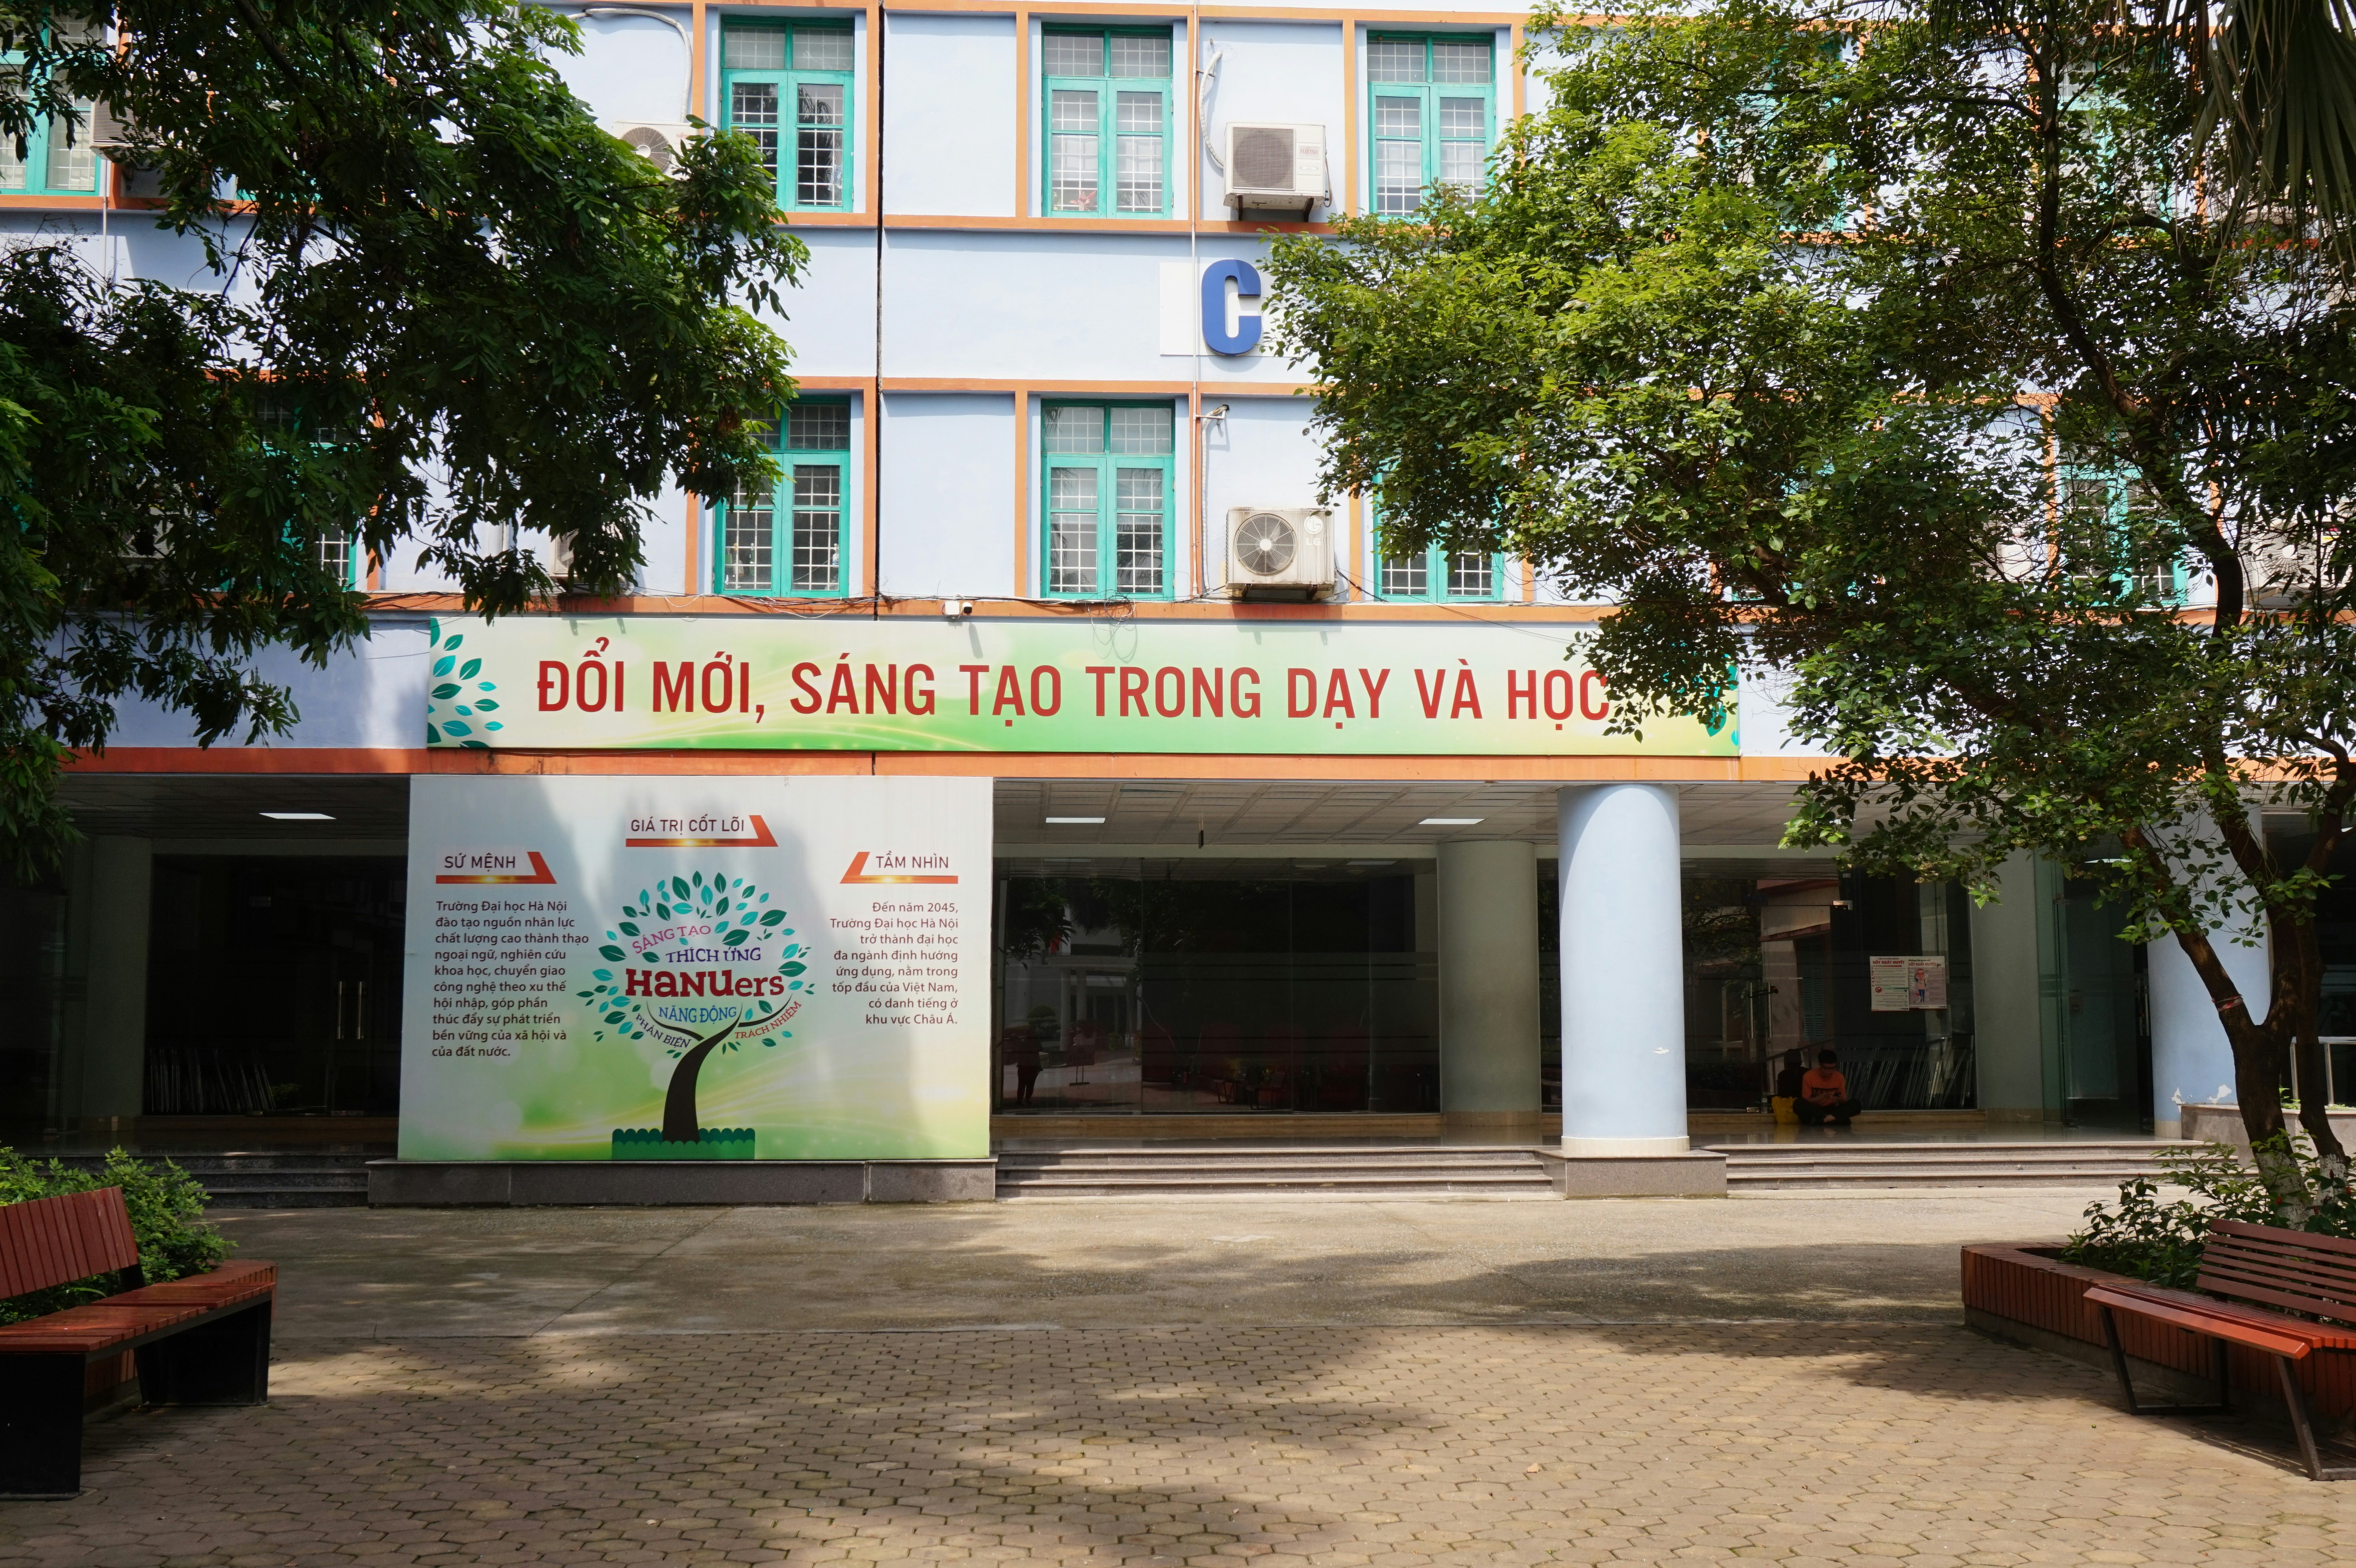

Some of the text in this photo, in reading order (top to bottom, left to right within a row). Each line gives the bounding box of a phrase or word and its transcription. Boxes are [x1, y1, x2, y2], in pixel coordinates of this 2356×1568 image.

[1202, 259, 1262, 356] C
[1306, 537, 1321, 546] LG
[537, 637, 1610, 730] ĐỔI MỚI, SÁNG TẠO TRONG DẠY VÀ HỌC
[631, 814, 744, 835] GIÁ TRỊ CỐT LÕI
[444, 853, 515, 872] SỨ MỆNH
[876, 850, 948, 868] TẦM NHÌN
[436, 901, 567, 914] Trường Đại học Hà Nội
[872, 901, 958, 913] Đến năm 2045,
[436, 916, 574, 929] đào tạo nguồn nhân lực
[830, 918, 958, 930] Trường Đại học Hà Nội
[435, 932, 461, 943] chất
[464, 933, 497, 945] lượng
[524, 933, 558, 943] thành
[562, 933, 589, 945] thạo
[632, 926, 711, 954] SÁNG TẠO
[860, 934, 958, 946] trở thành đại học
[435, 949, 566, 961] ngoại ngữ, nghiên cứu
[665, 947, 760, 963] THÍCH ỨNG
[834, 950, 957, 962] đa ngành định hướng
[435, 964, 565, 978] khoa học, chuyển giao
[836, 965, 957, 978] ứng dụng, nằm trong
[434, 981, 462, 994] công
[466, 981, 496, 994] nghệ
[499, 981, 526, 991] theo
[547, 980, 567, 991] thế
[832, 981, 957, 994] tốp đầu của Việt Nam,
[434, 996, 547, 1010] hội nhập, góp phần
[869, 997, 958, 1010] có danh tiếng ở
[433, 1012, 560, 1026] thúc đẩy sự phát triển
[659, 1005, 736, 1024] NĂNG ĐỘNG
[735, 1001, 801, 1038] TRÁCH NHIỆM
[866, 1012, 957, 1026] khu vực Châu Á.
[433, 1029, 566, 1043] bền vững của xã hội và
[636, 1013, 692, 1048] PHẢN BIỆN
[432, 1045, 510, 1056] của đất nước.
